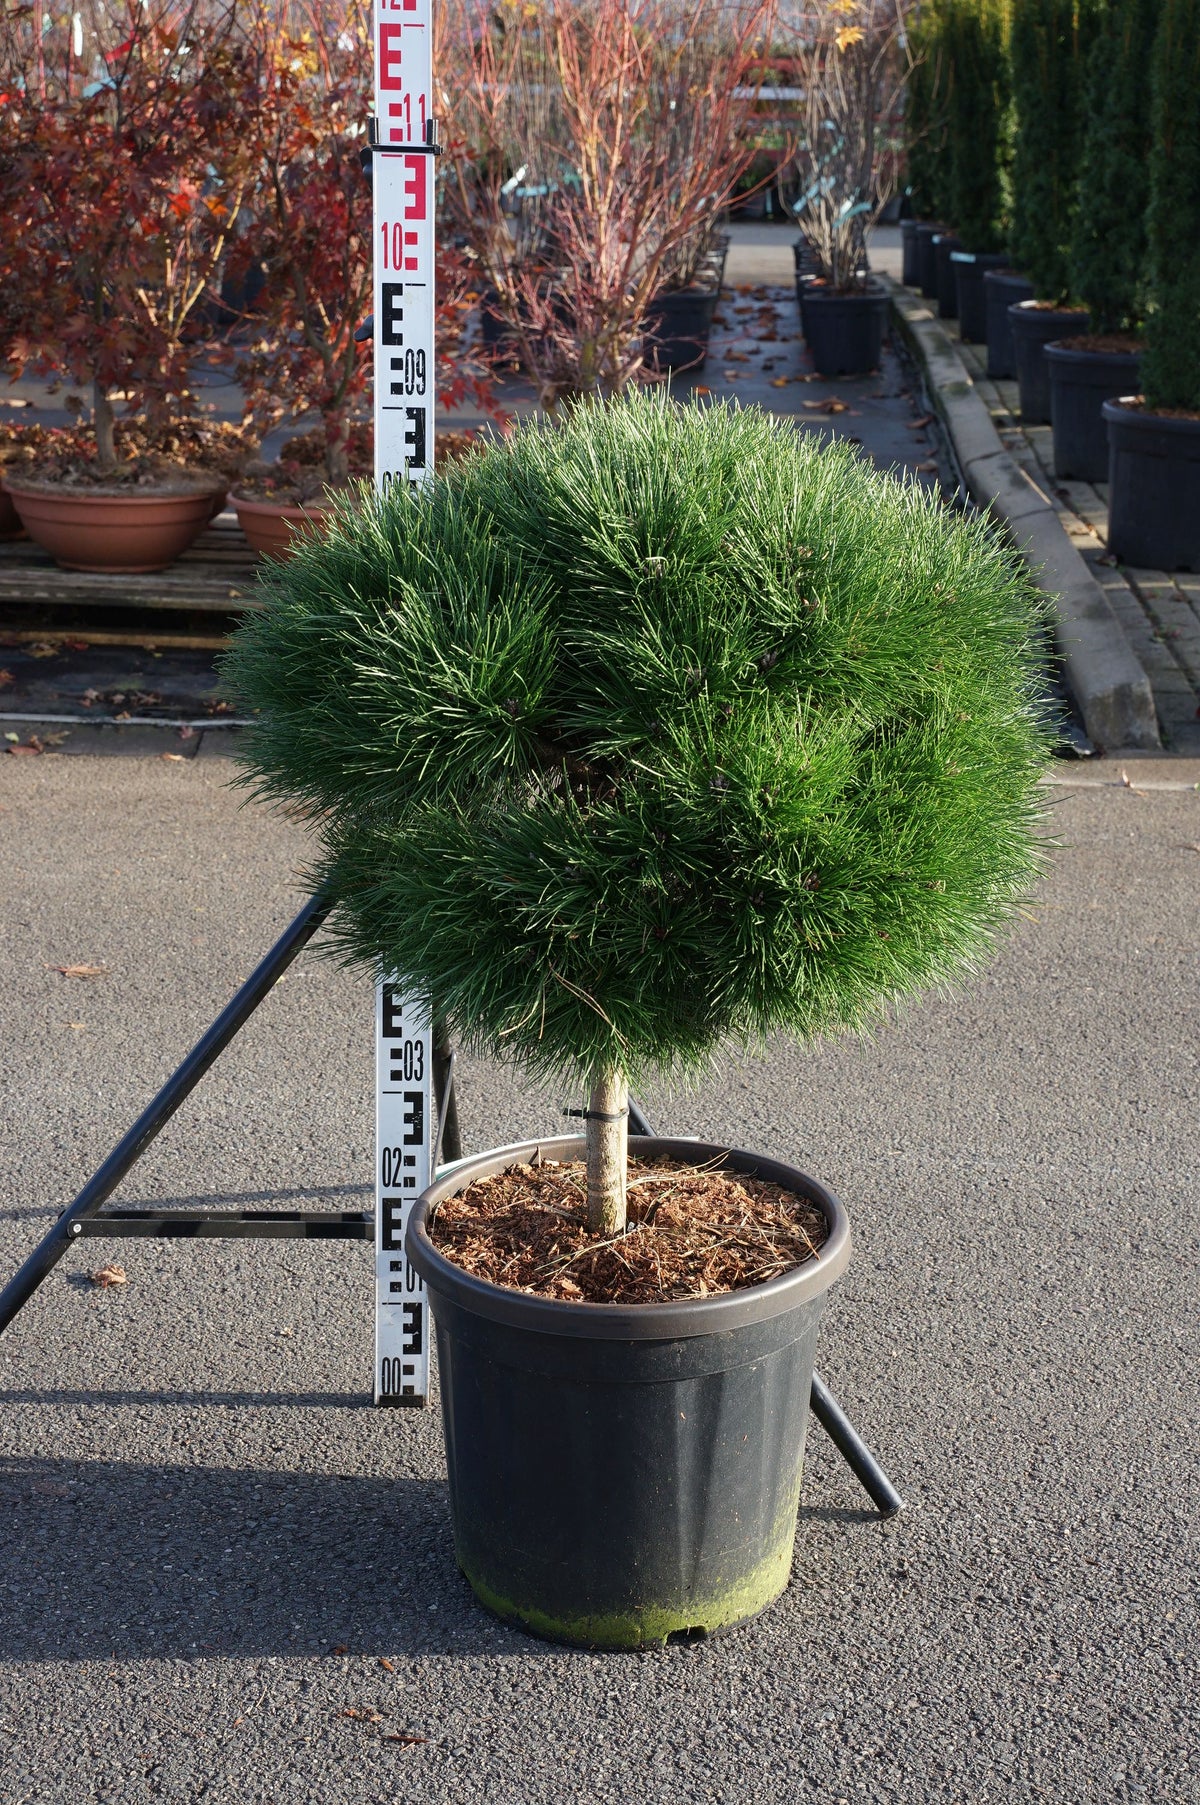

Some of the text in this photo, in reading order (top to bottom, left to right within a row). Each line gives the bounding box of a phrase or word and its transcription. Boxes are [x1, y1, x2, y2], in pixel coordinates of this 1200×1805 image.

[403, 93, 427, 142] 11
[381, 221, 403, 271] 10
[404, 348, 426, 396] 09
[403, 1039, 424, 1082] 03
[382, 1146, 402, 1188] 02
[381, 1356, 401, 1396] 00
